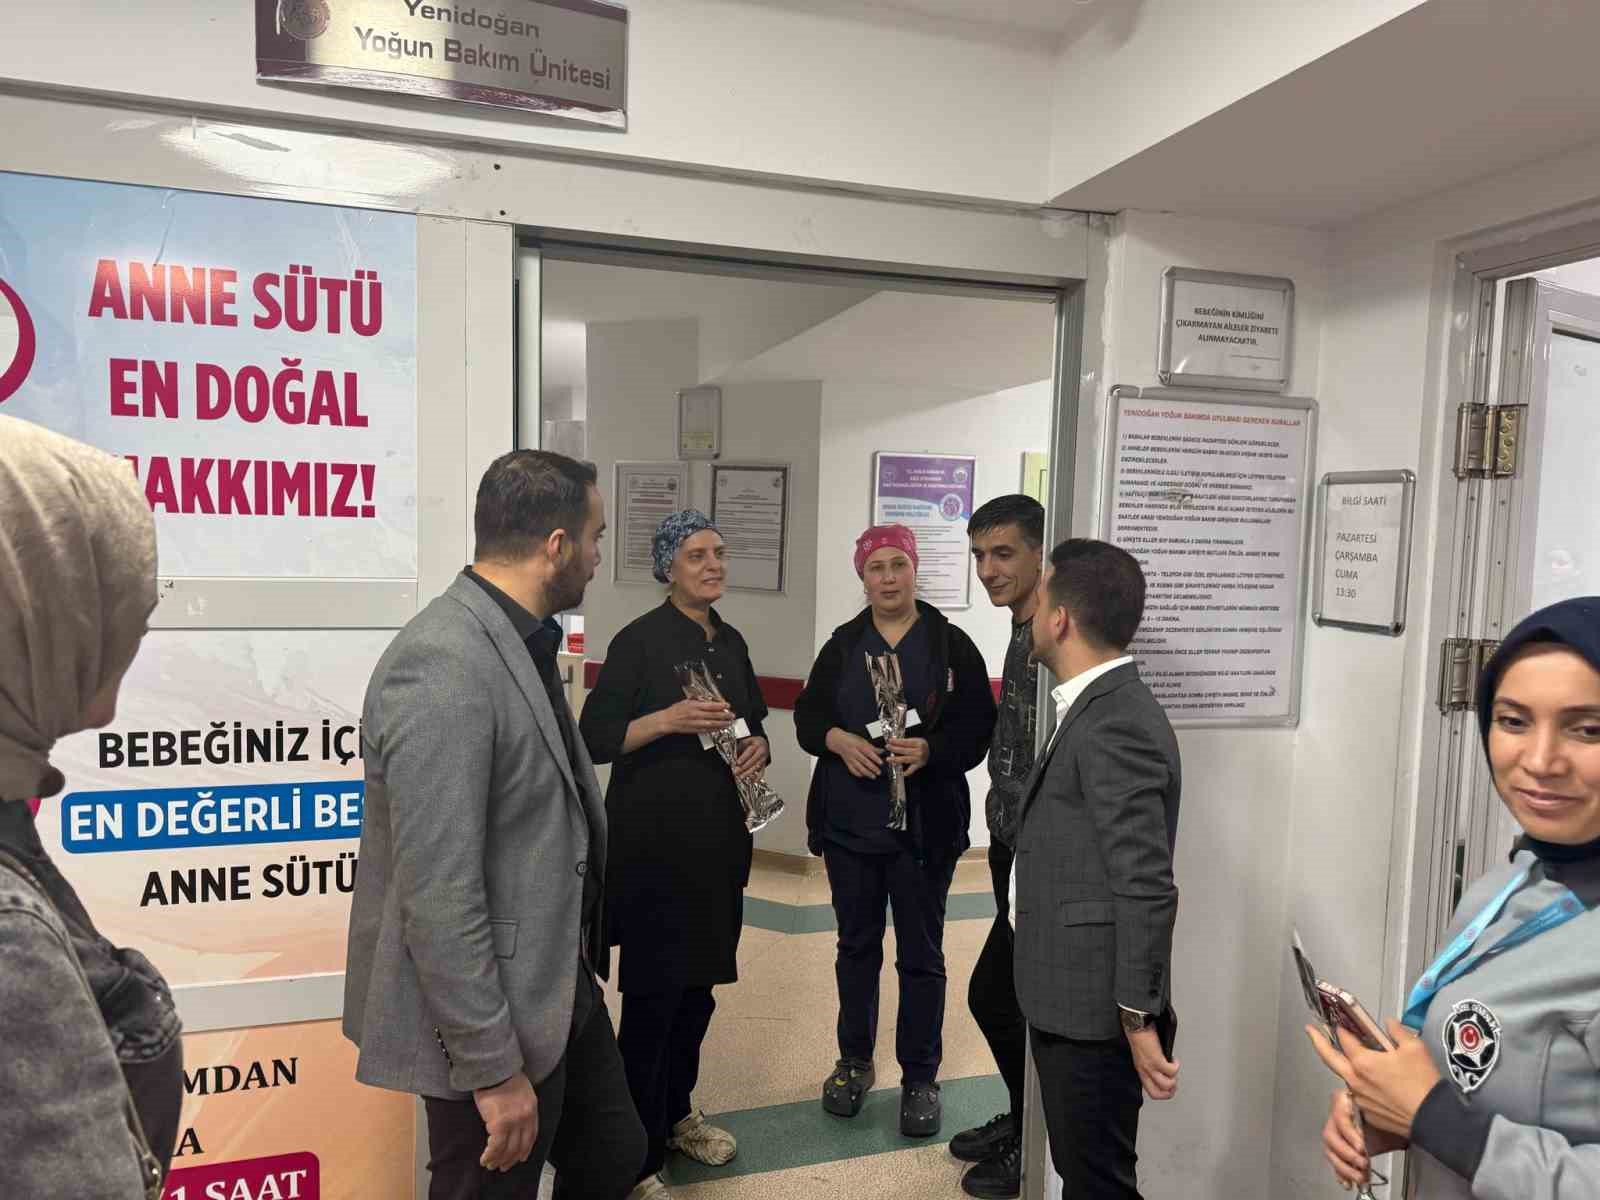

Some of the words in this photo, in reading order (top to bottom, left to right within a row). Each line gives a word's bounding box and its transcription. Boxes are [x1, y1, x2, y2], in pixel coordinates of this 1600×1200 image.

[405, 0, 540, 39] Yenidoğan
[355, 26, 433, 60] Yoğun
[444, 39, 520, 73] Bakım
[530, 48, 611, 91] Ünitesi
[88, 258, 238, 327] ANNE
[253, 263, 383, 337] SÜTÜ
[109, 357, 179, 419] EN
[195, 357, 369, 428] DOĞAL
[122, 454, 376, 519] AKKIMIZ!
[1335, 568, 1359, 580] CUMA
[99, 720, 309, 769] BEBEĞİNİZ
[69, 802, 123, 842] EN
[136, 788, 301, 838] DEĞERLİ
[314, 791, 365, 828] BE
[140, 864, 251, 908] ANNE
[261, 852, 359, 899] SÜTÜ
[205, 1168, 307, 1200] SAAT
